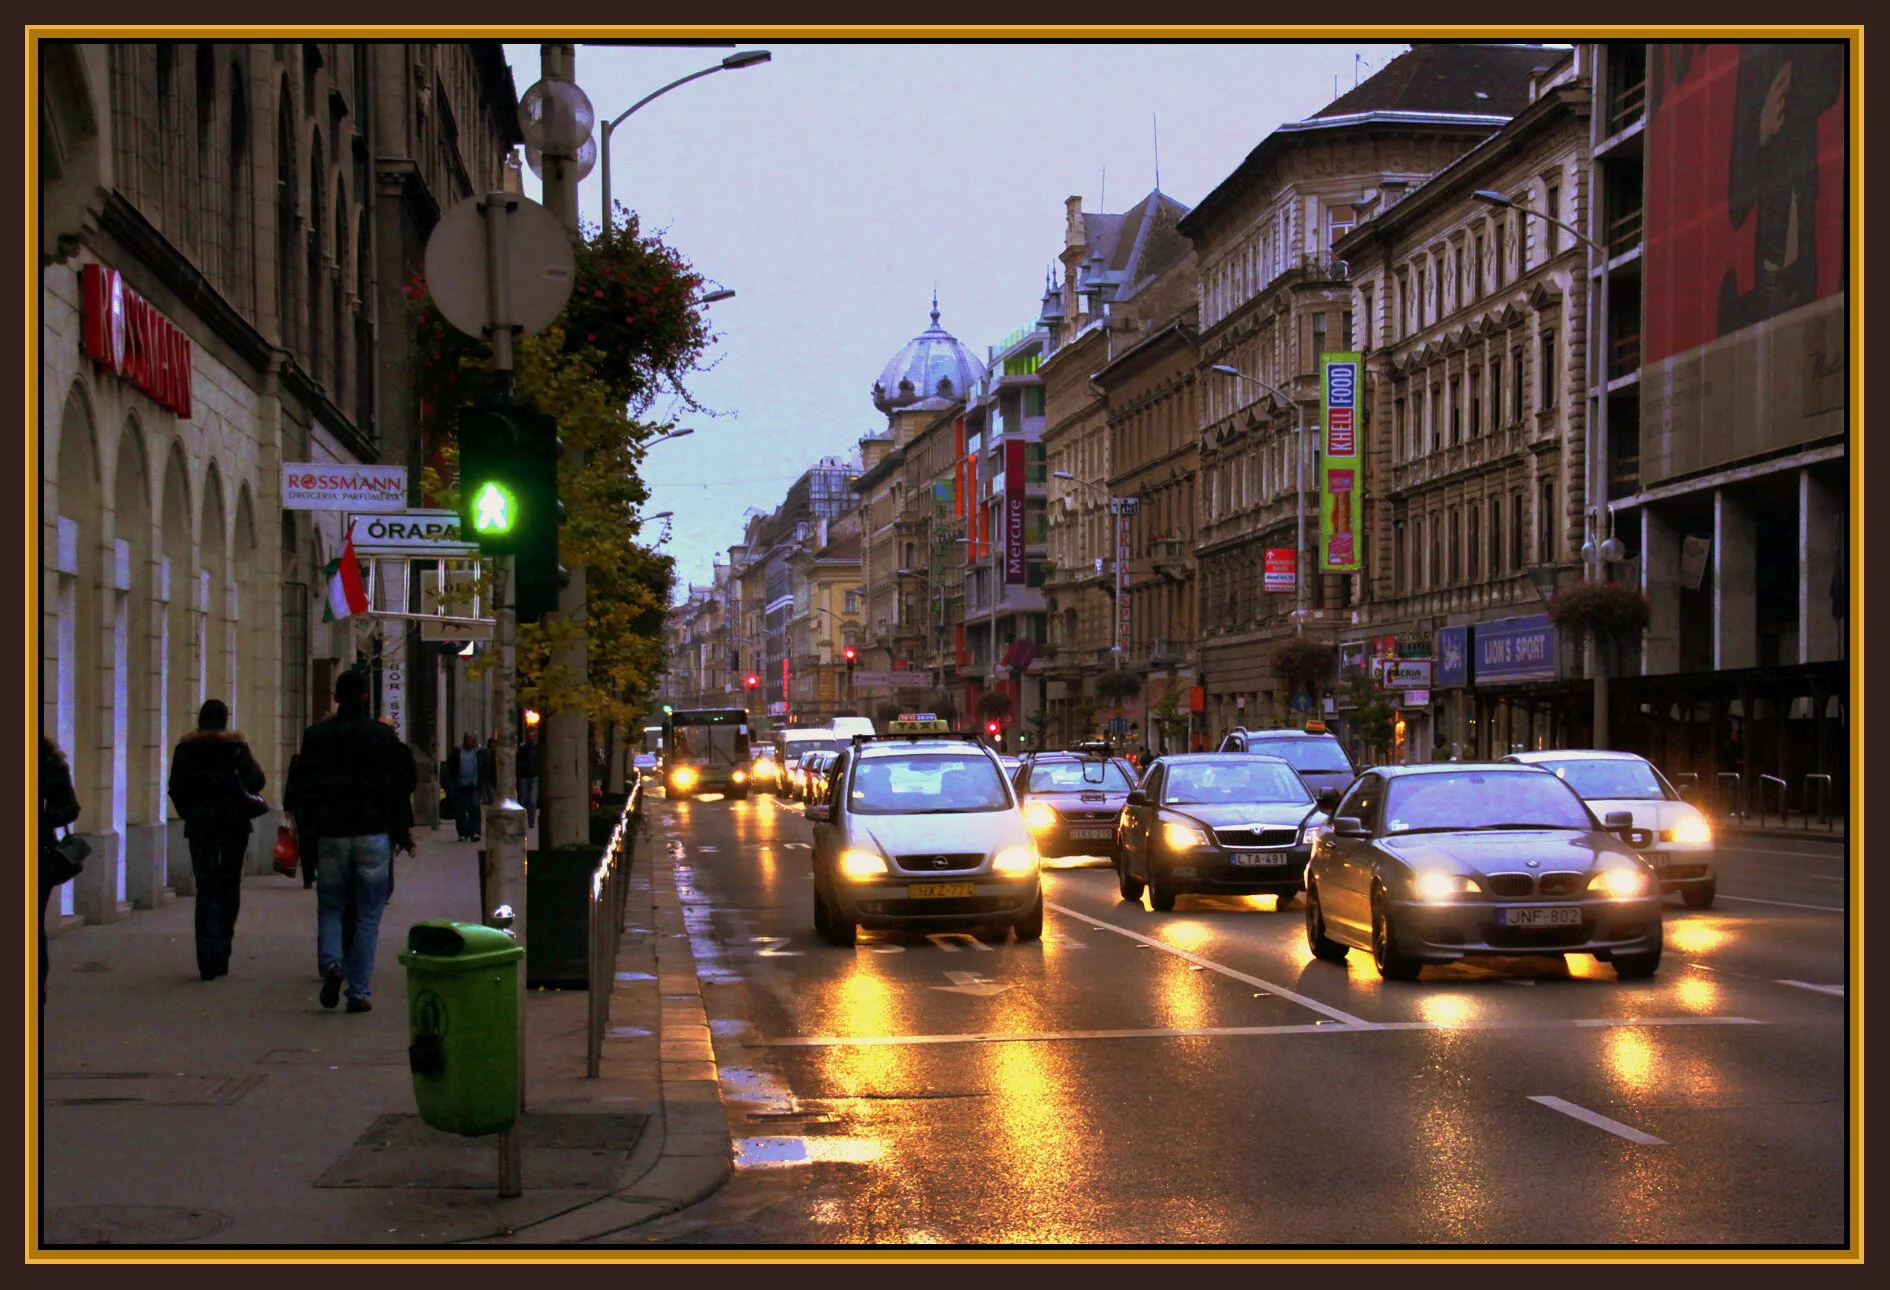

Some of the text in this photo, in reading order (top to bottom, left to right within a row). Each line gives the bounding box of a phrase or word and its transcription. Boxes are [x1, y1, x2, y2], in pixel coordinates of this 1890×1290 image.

[1330, 368, 1352, 404] FOOD
[1330, 411, 1352, 451] KHELL
[288, 474, 401, 490] ROSSMANN
[1009, 499, 1021, 574] Mercure
[1515, 634, 1545, 662] SPORT
[898, 722, 938, 730] TAXI
[1510, 909, 1578, 924] JNF-802
